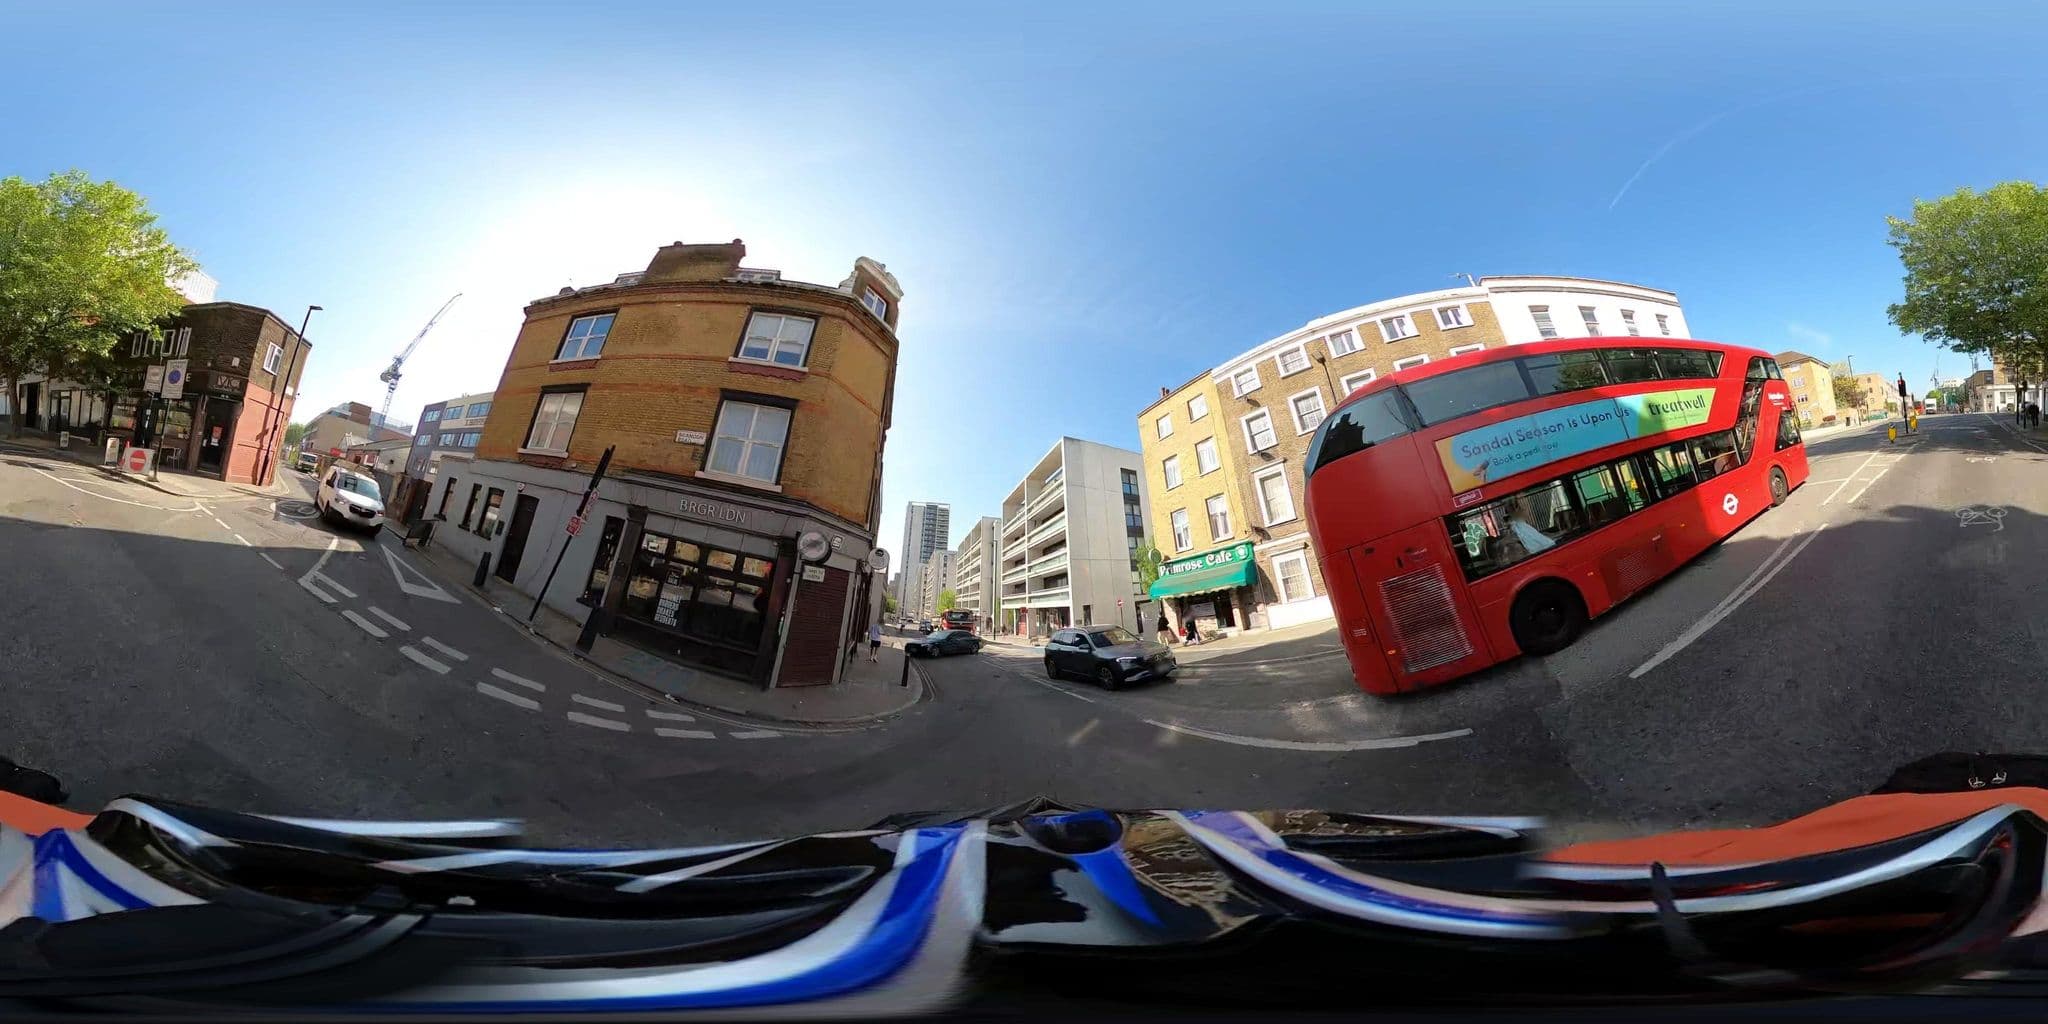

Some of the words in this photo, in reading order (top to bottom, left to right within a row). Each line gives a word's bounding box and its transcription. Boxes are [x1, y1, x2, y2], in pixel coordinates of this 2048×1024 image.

[1648, 394, 1706, 416] treatwell
[1461, 432, 1513, 458] Sandal
[1516, 422, 1565, 439] Season
[1580, 411, 1612, 426] Upon
[1614, 407, 1630, 418] Us
[1493, 454, 1515, 466] Book
[679, 499, 715, 518] BRGR
[719, 506, 746, 523] LDN
[1160, 558, 1203, 577] Primrose
[1206, 550, 1233, 566] Cafe
